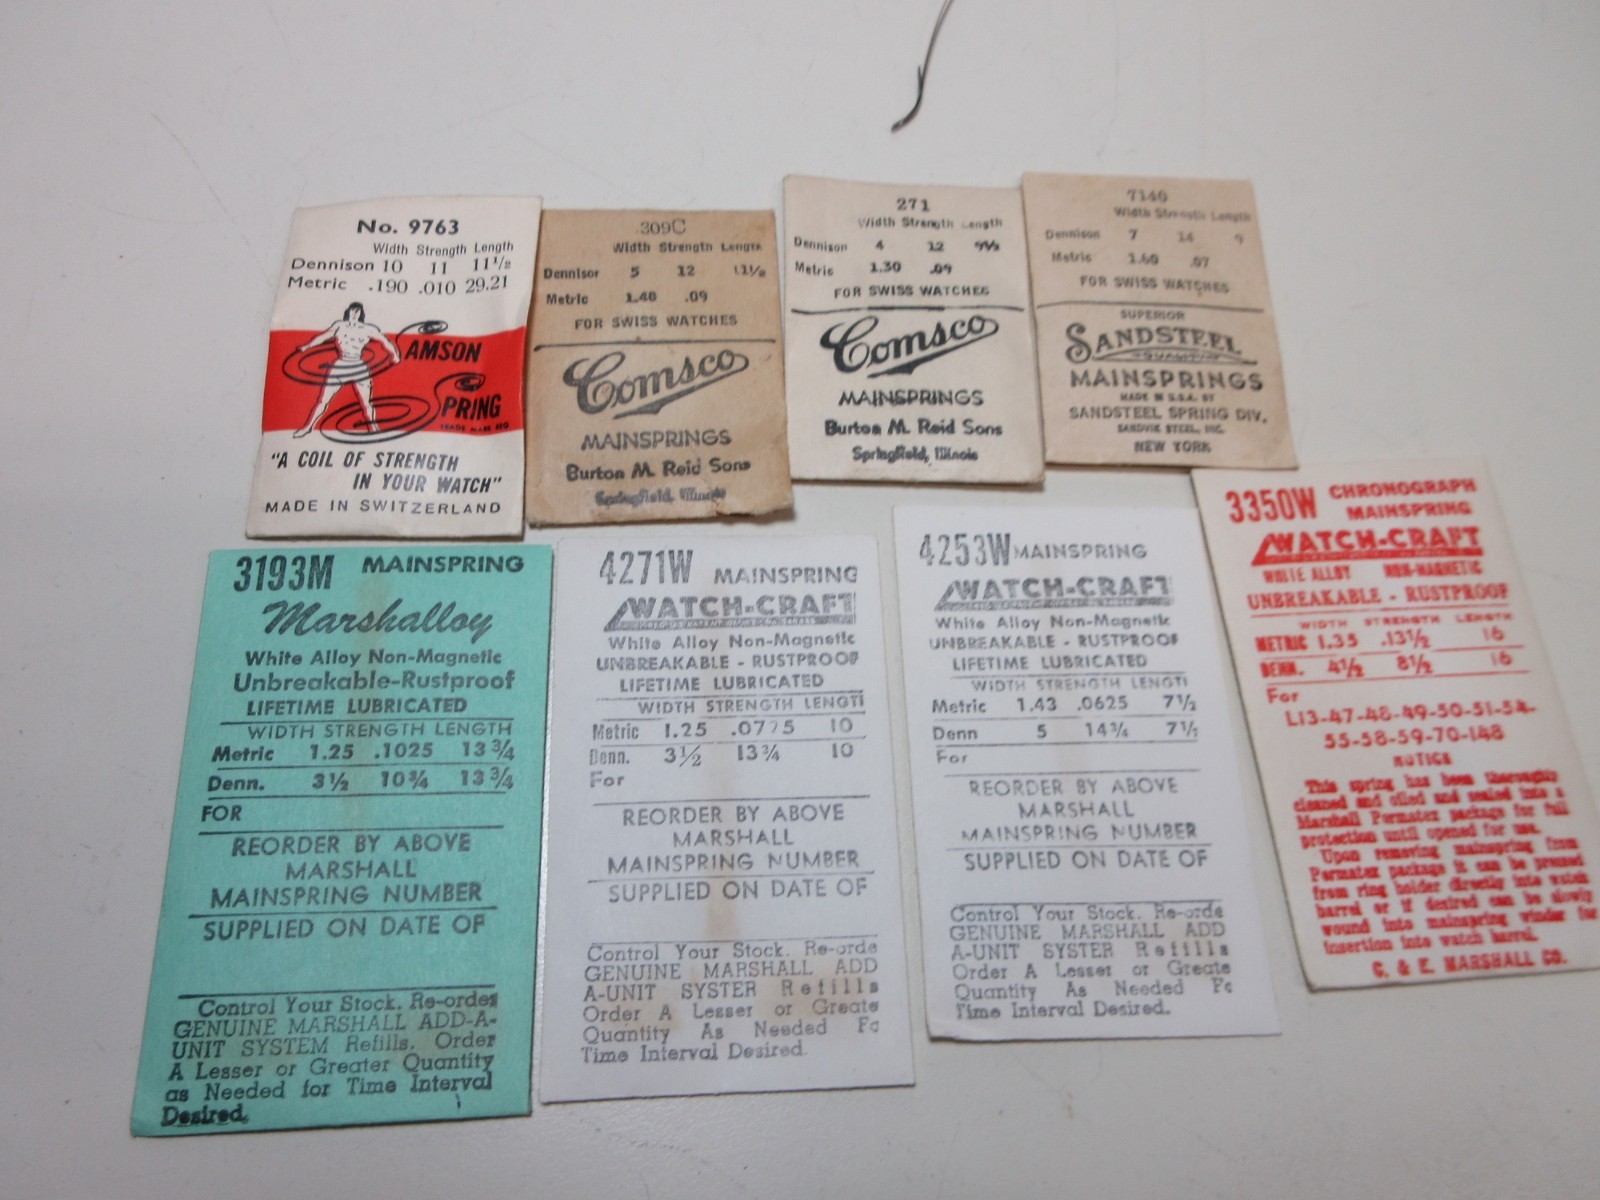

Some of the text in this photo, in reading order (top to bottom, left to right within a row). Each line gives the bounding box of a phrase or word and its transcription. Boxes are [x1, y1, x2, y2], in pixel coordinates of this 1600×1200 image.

[897, 198, 930, 212] 271
[1114, 207, 1150, 218] Width
[357, 219, 460, 235] No. 9763
[1046, 230, 1100, 240] Dennison
[1128, 229, 1137, 240] 7
[373, 241, 514, 257] Width Strength Length
[613, 242, 650, 253] Width
[794, 236, 944, 252] Dennison 4 12
[291, 258, 447, 275] Dennison 10 11
[1052, 253, 1092, 263] Metric
[630, 265, 695, 278] 5 12
[795, 262, 833, 276] Metric
[870, 262, 901, 273] 1.30
[288, 276, 508, 295] Metric .190 .010 29.21
[834, 288, 861, 299] FOR
[869, 286, 913, 296] SWISS
[1080, 276, 1229, 293] FOR SWISS WATCHES
[547, 294, 588, 305] Metric
[685, 291, 708, 302] .09
[575, 315, 737, 330] FOR SWISS WATCHES
[1120, 310, 1185, 320] SUPERIOR
[820, 316, 999, 373] Comsco
[1066, 322, 1242, 364] SANDSTEEL
[563, 349, 749, 414] Comsco
[1070, 369, 1263, 391] MAINSPRINGS
[838, 389, 984, 407] MAINSPRINGS
[1069, 406, 1268, 424] SANDSTEEL SPRING DIV.
[825, 419, 881, 436] Burton
[918, 418, 955, 435] Reid
[962, 419, 1003, 436] Sons
[581, 429, 732, 451] MAINSPRINGS
[1134, 441, 1212, 453] NEW YORK
[298, 452, 333, 468] COIL
[344, 452, 365, 467] OF
[374, 453, 459, 472] STRENGTH
[566, 464, 625, 481] Burton
[663, 459, 701, 477] Reid
[709, 457, 751, 472] Sons
[353, 473, 371, 489] IN
[382, 474, 427, 492] YOUR
[265, 500, 500, 514] MADE IN SWITZERLAND
[1225, 478, 1477, 523] 3350W CHRONOGRAPH
[1346, 501, 1472, 520] MAINSPRING
[919, 532, 1148, 566] 4253W MAINSPRING
[1256, 526, 1482, 558] WATCH-CRAFT
[233, 555, 524, 592] 3193M MAINSPRING
[600, 549, 857, 585] 4271W MAINSPRING
[1247, 589, 1382, 611] UNBREAKABLE
[262, 599, 493, 645] Marshalloy
[609, 631, 855, 650] White Alloy Non-Magnetic
[1318, 633, 1359, 650] 1.35
[246, 649, 502, 667] White Alloy Non-Magnetic
[953, 654, 1147, 670] LIFETIME LUBRICATED
[233, 670, 515, 692] Unbreakable-Rustproof
[620, 674, 824, 692] LIFETIME LUBRICATED
[247, 698, 467, 716] LIFETIME LUBRICATED
[932, 695, 1128, 714] Metric 1.43 .0625
[248, 722, 512, 740] WIDTH STRENGTH LENGTH
[593, 722, 707, 740] Metric 1.25
[212, 742, 433, 762] Metric 1.25 .1025
[208, 776, 264, 792] Denn.
[201, 805, 242, 822] FOR
[1017, 800, 1135, 819] MARSHALL
[231, 833, 471, 857] REORDER BY ABOVE
[286, 860, 416, 881] MARSHALL
[608, 851, 860, 875] MAINSPRING NUMBER
[211, 882, 482, 909] MAINSPRING NUMBER
[204, 915, 485, 941] SUPPLIED ON DATE OF
[584, 960, 813, 982] GENUINE MARSHALL
[953, 962, 1112, 979] Order Lesser
[1444, 951, 1534, 972] MARSHALL
[199, 993, 401, 1018] Control Your Stock.
[174, 1019, 276, 1038] GENUINE
[289, 1015, 407, 1034] MARSHALL
[172, 1032, 496, 1059] UNIT SYSTEM Refills. Order
[196, 1053, 495, 1081] Lesser or Greater Quantity
